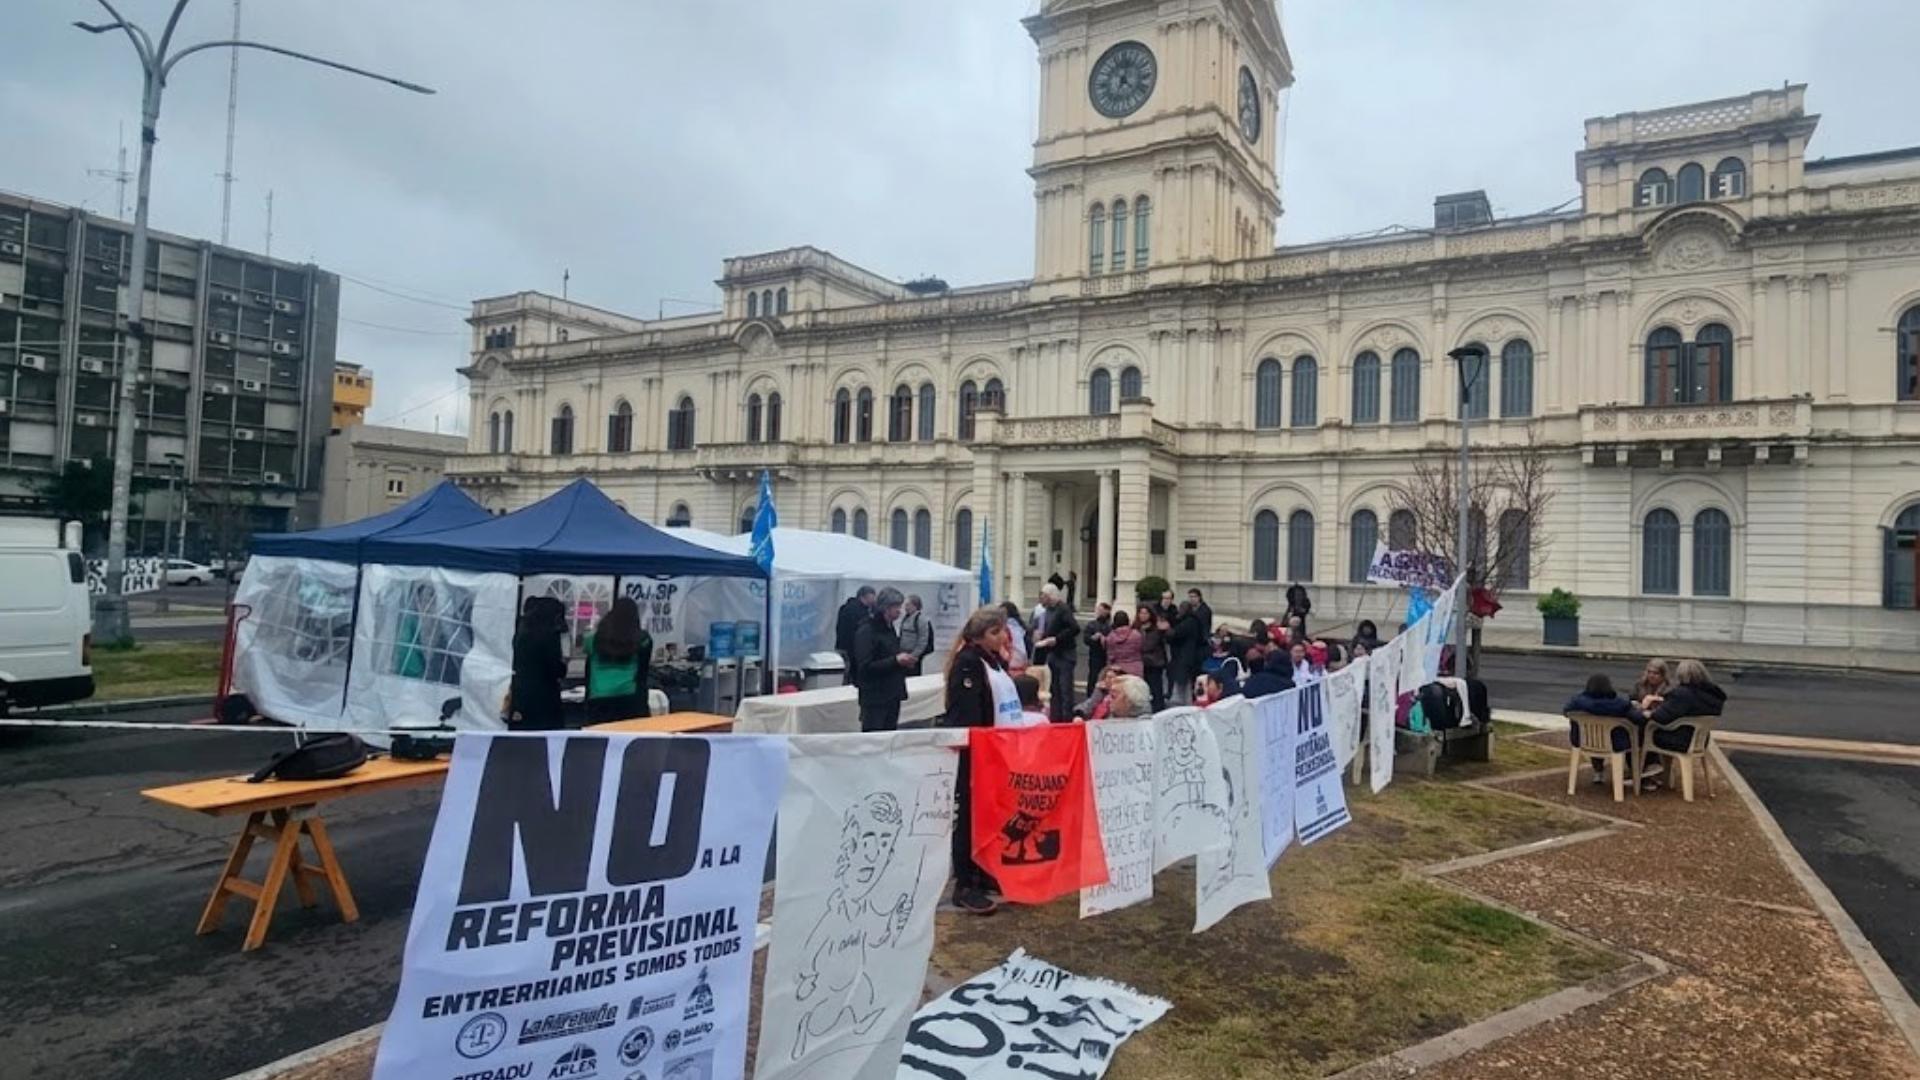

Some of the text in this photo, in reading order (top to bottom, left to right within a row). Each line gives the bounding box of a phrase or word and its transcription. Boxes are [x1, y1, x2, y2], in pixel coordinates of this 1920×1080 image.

[1298, 683, 1323, 735] NO
[457, 736, 711, 906] NO
[700, 844, 741, 869] A LA
[445, 884, 665, 952] REFORMA
[551, 906, 739, 971] PREVISIONAL
[422, 966, 617, 1018] ENTRERRIANOS
[623, 949, 687, 981] SOMOS
[694, 936, 742, 965] TODOS
